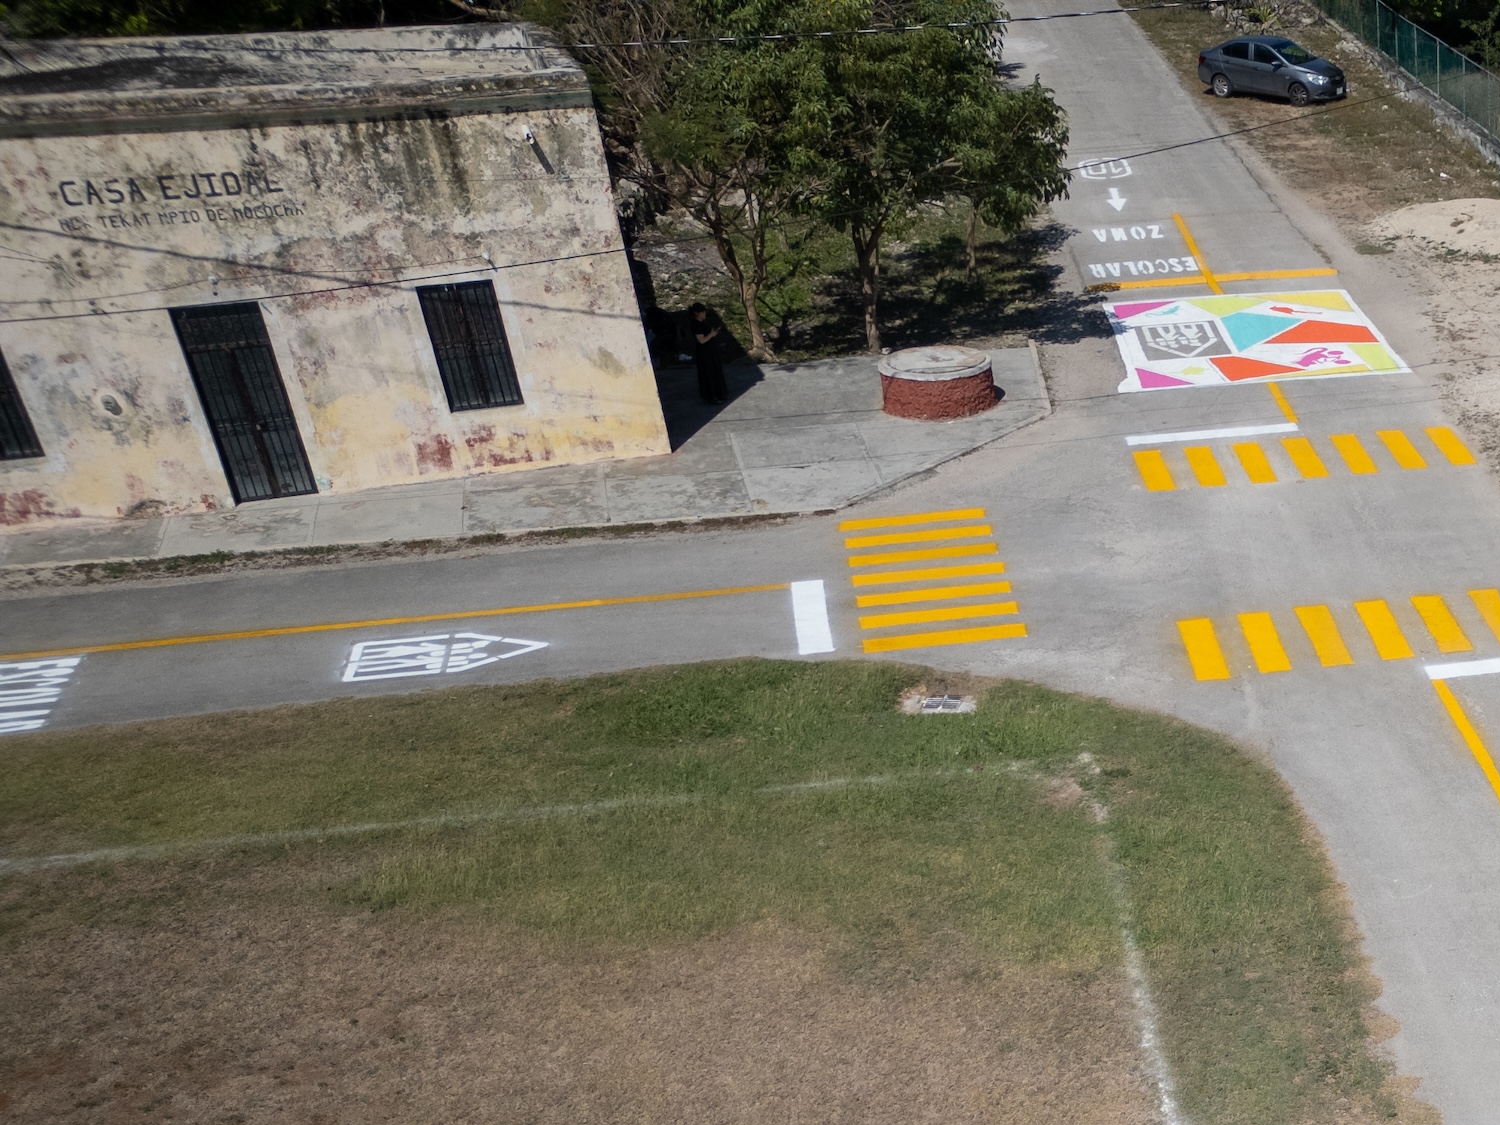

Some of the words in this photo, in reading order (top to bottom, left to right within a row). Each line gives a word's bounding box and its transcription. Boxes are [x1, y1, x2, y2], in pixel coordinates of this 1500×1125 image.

[59, 177, 148, 206] CASA
[157, 171, 284, 200] EJIDAL
[205, 208, 228, 221] DE
[1092, 225, 1164, 243] ZONA
[1087, 256, 1199, 278] ESCOLAR
